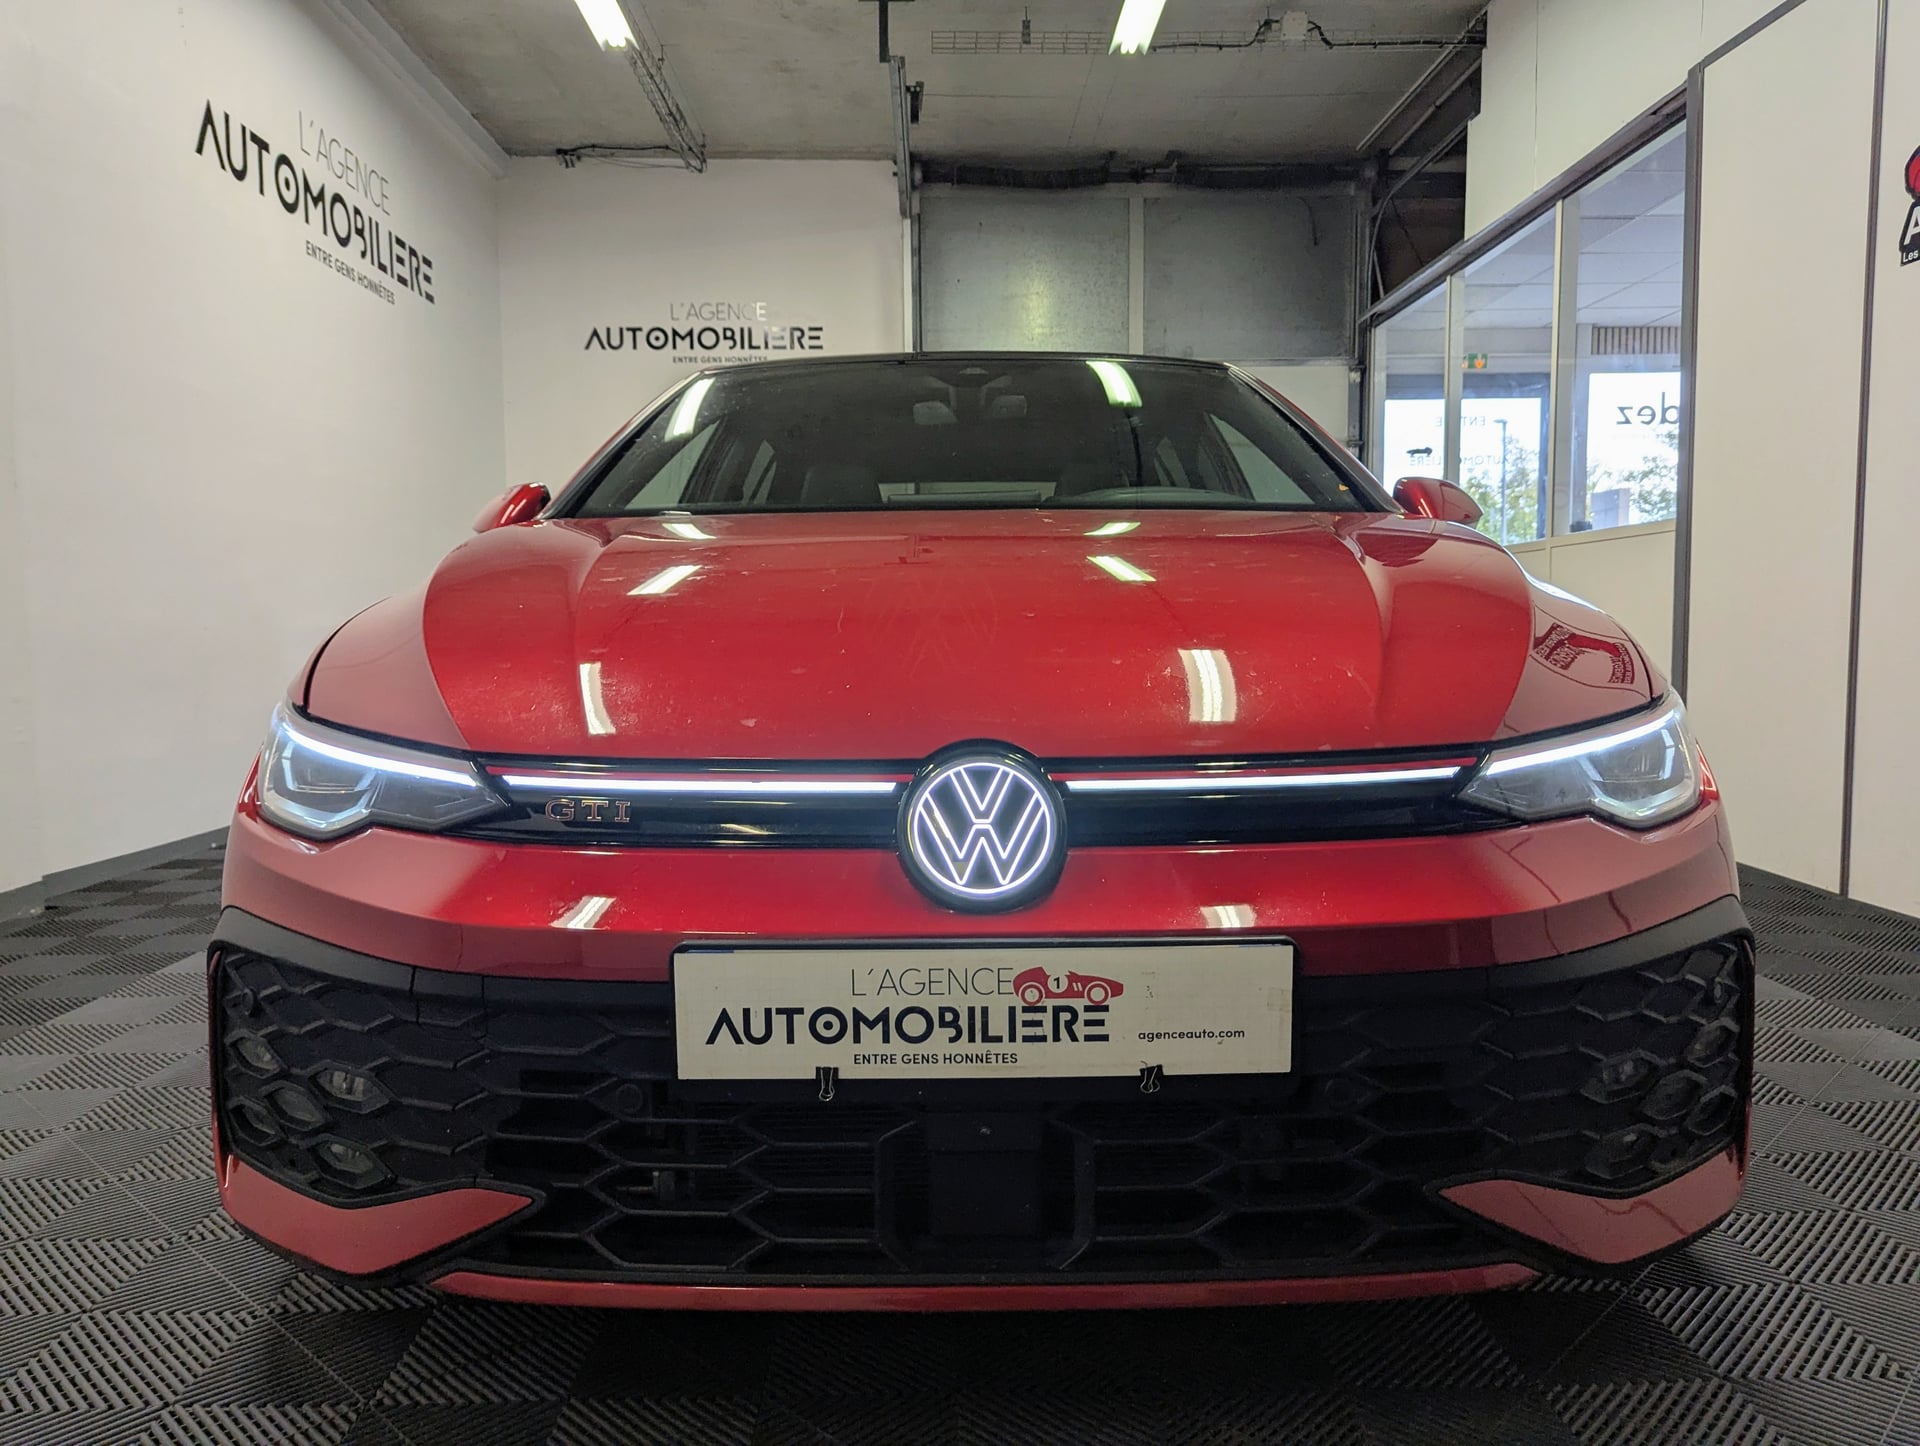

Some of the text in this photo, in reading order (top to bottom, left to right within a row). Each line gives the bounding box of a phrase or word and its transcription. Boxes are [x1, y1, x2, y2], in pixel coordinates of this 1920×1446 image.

[195, 98, 436, 304] AUTOMOBILIERE
[306, 240, 333, 269] ENTRE
[335, 258, 355, 282] GENS
[585, 326, 824, 351] AUTOMOBILIERE
[672, 355, 698, 364] ENTRE
[700, 355, 722, 364] GENS
[545, 799, 631, 822] GTI
[851, 967, 1014, 996] L'AGENCE
[705, 1004, 1110, 1046] AUTOMOBILIERE
[1138, 1027, 1245, 1042] agenceauto.com
[853, 1050, 1018, 1065] ENTRE GENS HONNÊTES
